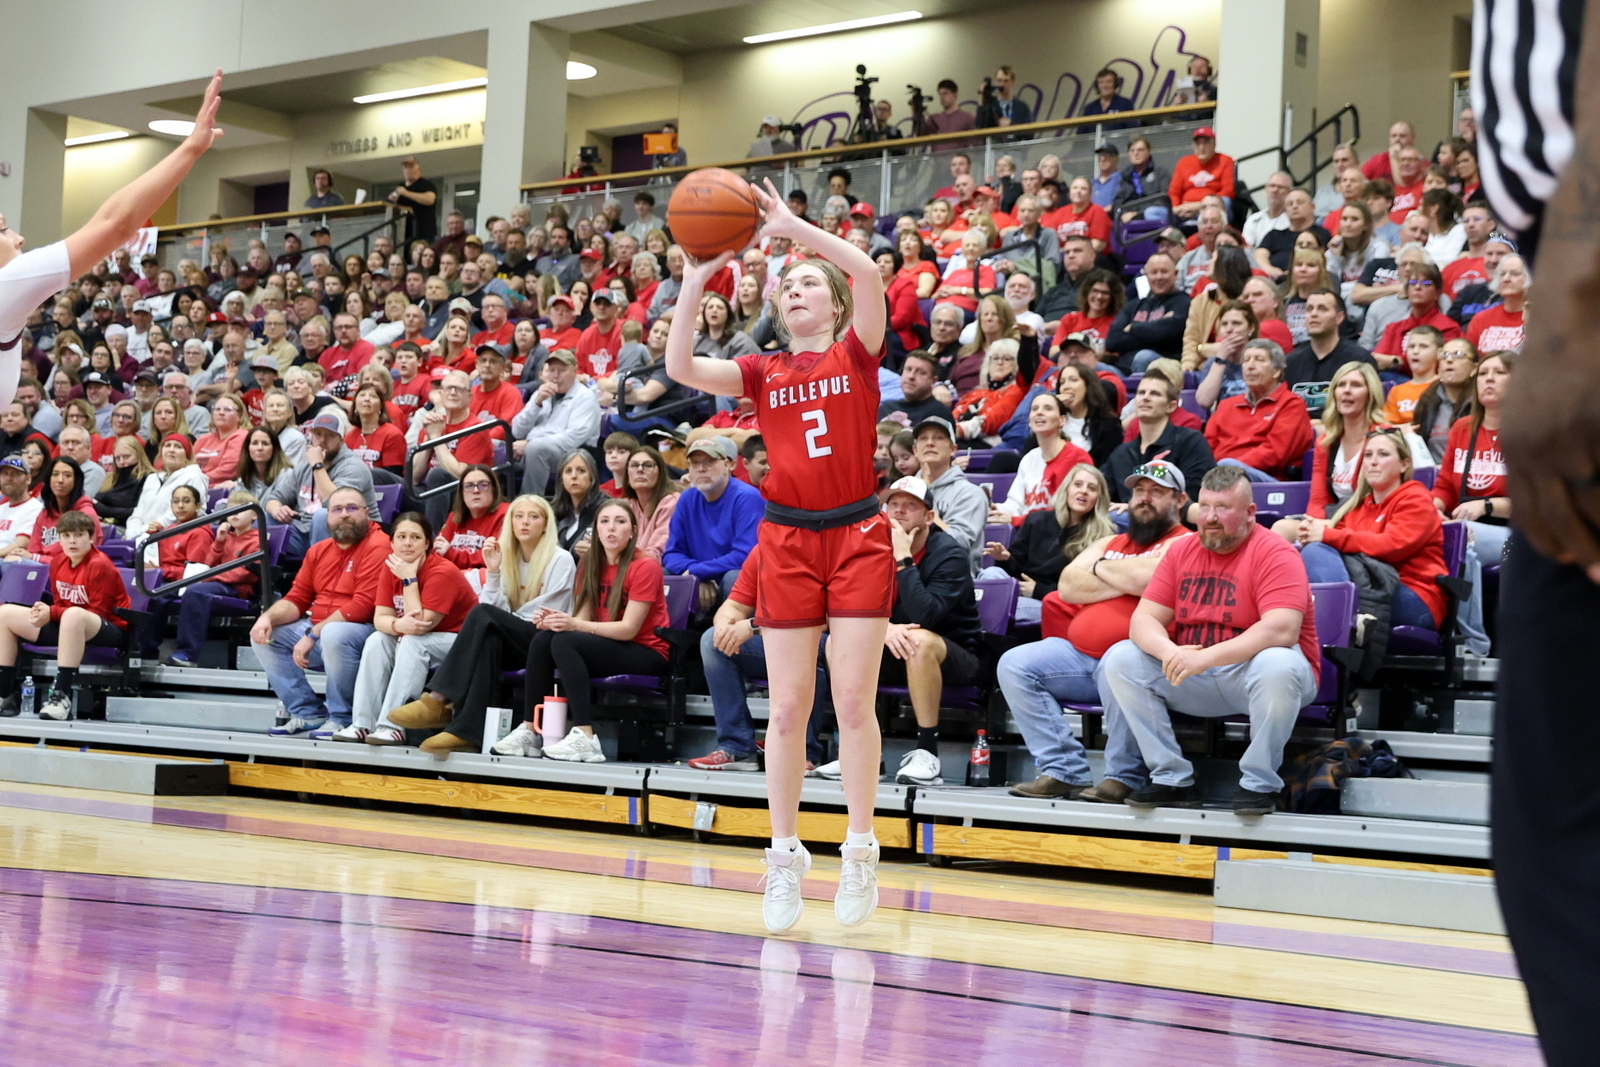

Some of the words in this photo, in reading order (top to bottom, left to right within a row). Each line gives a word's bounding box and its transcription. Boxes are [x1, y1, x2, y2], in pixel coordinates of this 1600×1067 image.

[387, 132, 413, 149] AND
[421, 123, 471, 144] WEIGHT
[769, 375, 851, 409] BELLEVUE
[801, 409, 832, 459] 2
[1178, 576, 1237, 606] STATE
[1179, 607, 1188, 618] 20
[1176, 622, 1244, 648] FINAL
